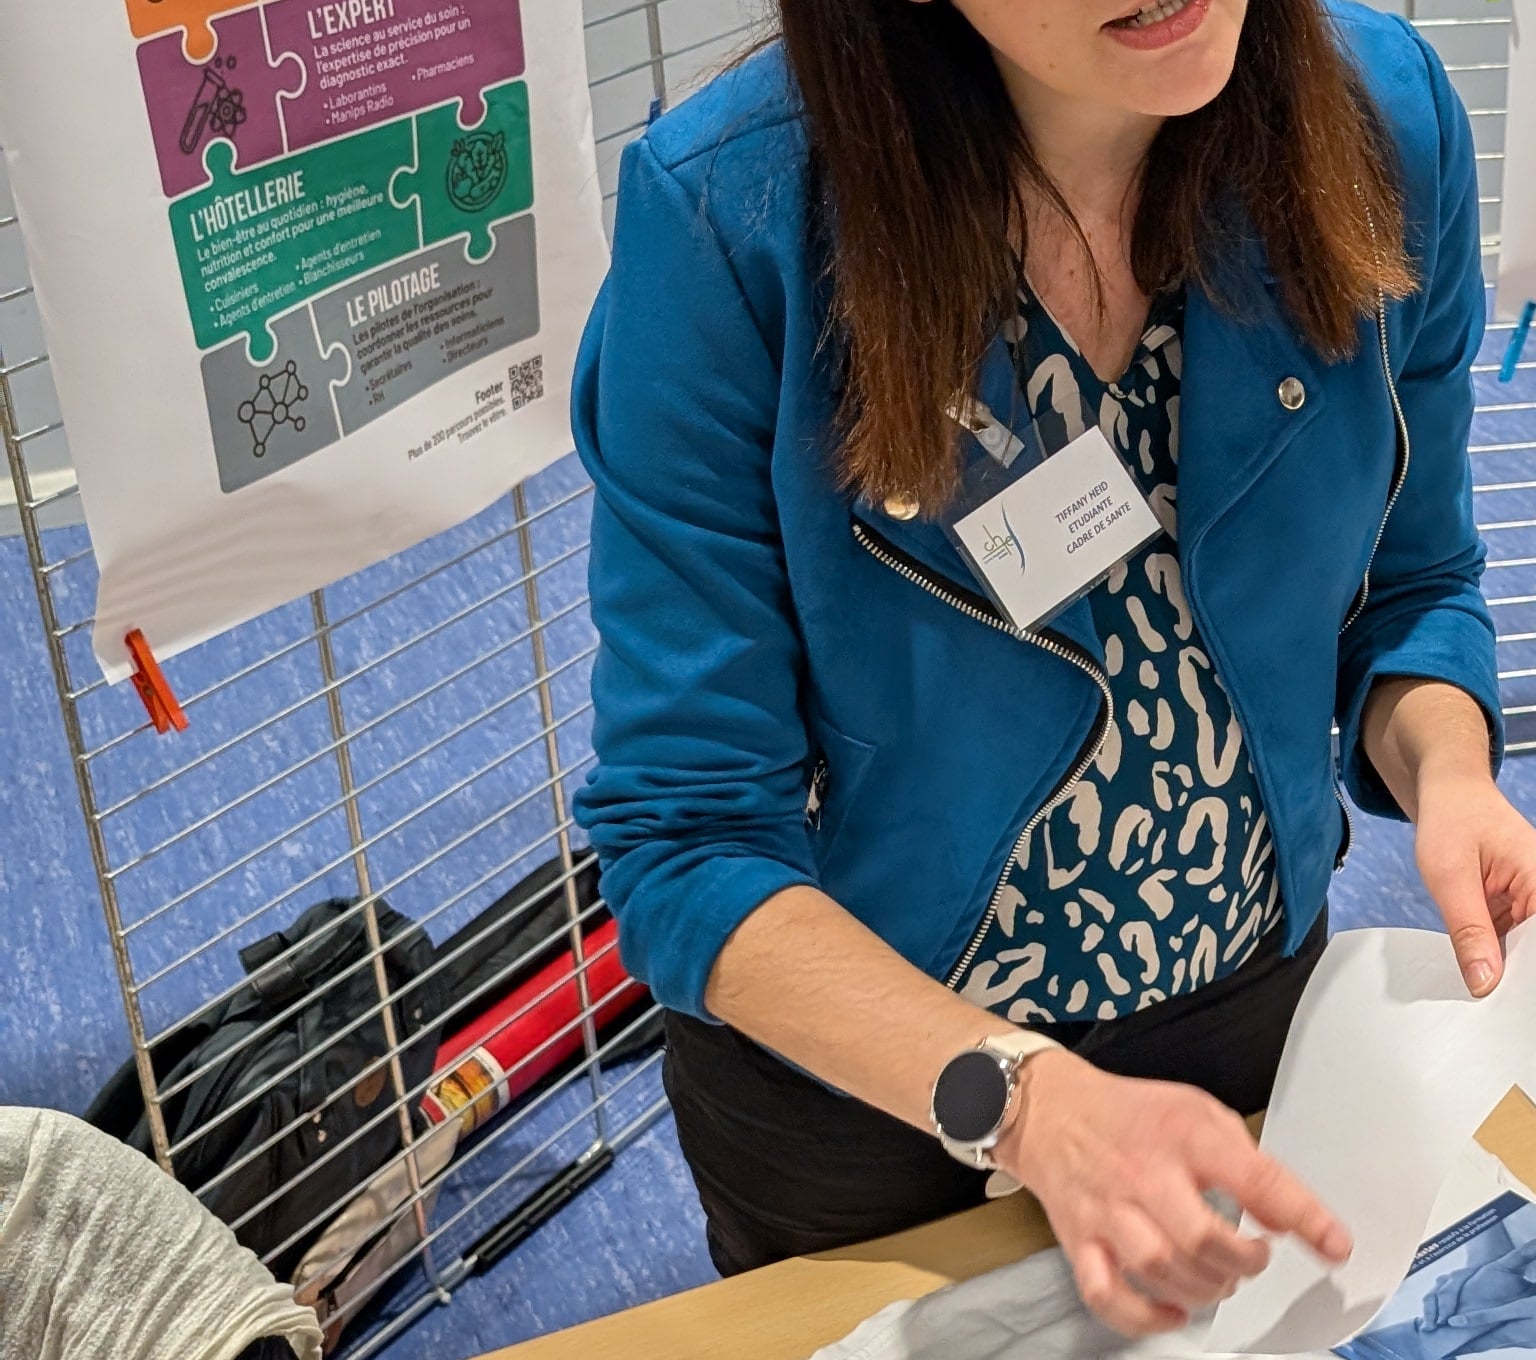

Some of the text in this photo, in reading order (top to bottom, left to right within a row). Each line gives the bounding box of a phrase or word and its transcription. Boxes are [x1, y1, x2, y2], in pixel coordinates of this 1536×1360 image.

[314, 6, 459, 59] La science au service du soin
[316, 18, 472, 74] l'expertise de précision pour un
[319, 54, 408, 90] diagnostic exact.
[417, 53, 474, 81] Pharmaciens
[329, 82, 387, 110] Laborantins
[331, 95, 394, 125] Manips Radio
[190, 170, 305, 242] L'HÔTELLERIE
[198, 203, 319, 262] Le bien-être au quotidien
[201, 193, 384, 277] nutrition et confort pour une meilleure
[346, 262, 440, 327] LE PILOTAGE
[353, 308, 413, 345] Les pilotes de
[406, 319, 418, 332] les
[475, 382, 504, 405] Footer
[1055, 481, 1108, 523] TIFFANY HEID
[1068, 496, 1113, 534] ETUDIANTE
[1067, 502, 1131, 553] CADRE DE SANTE
